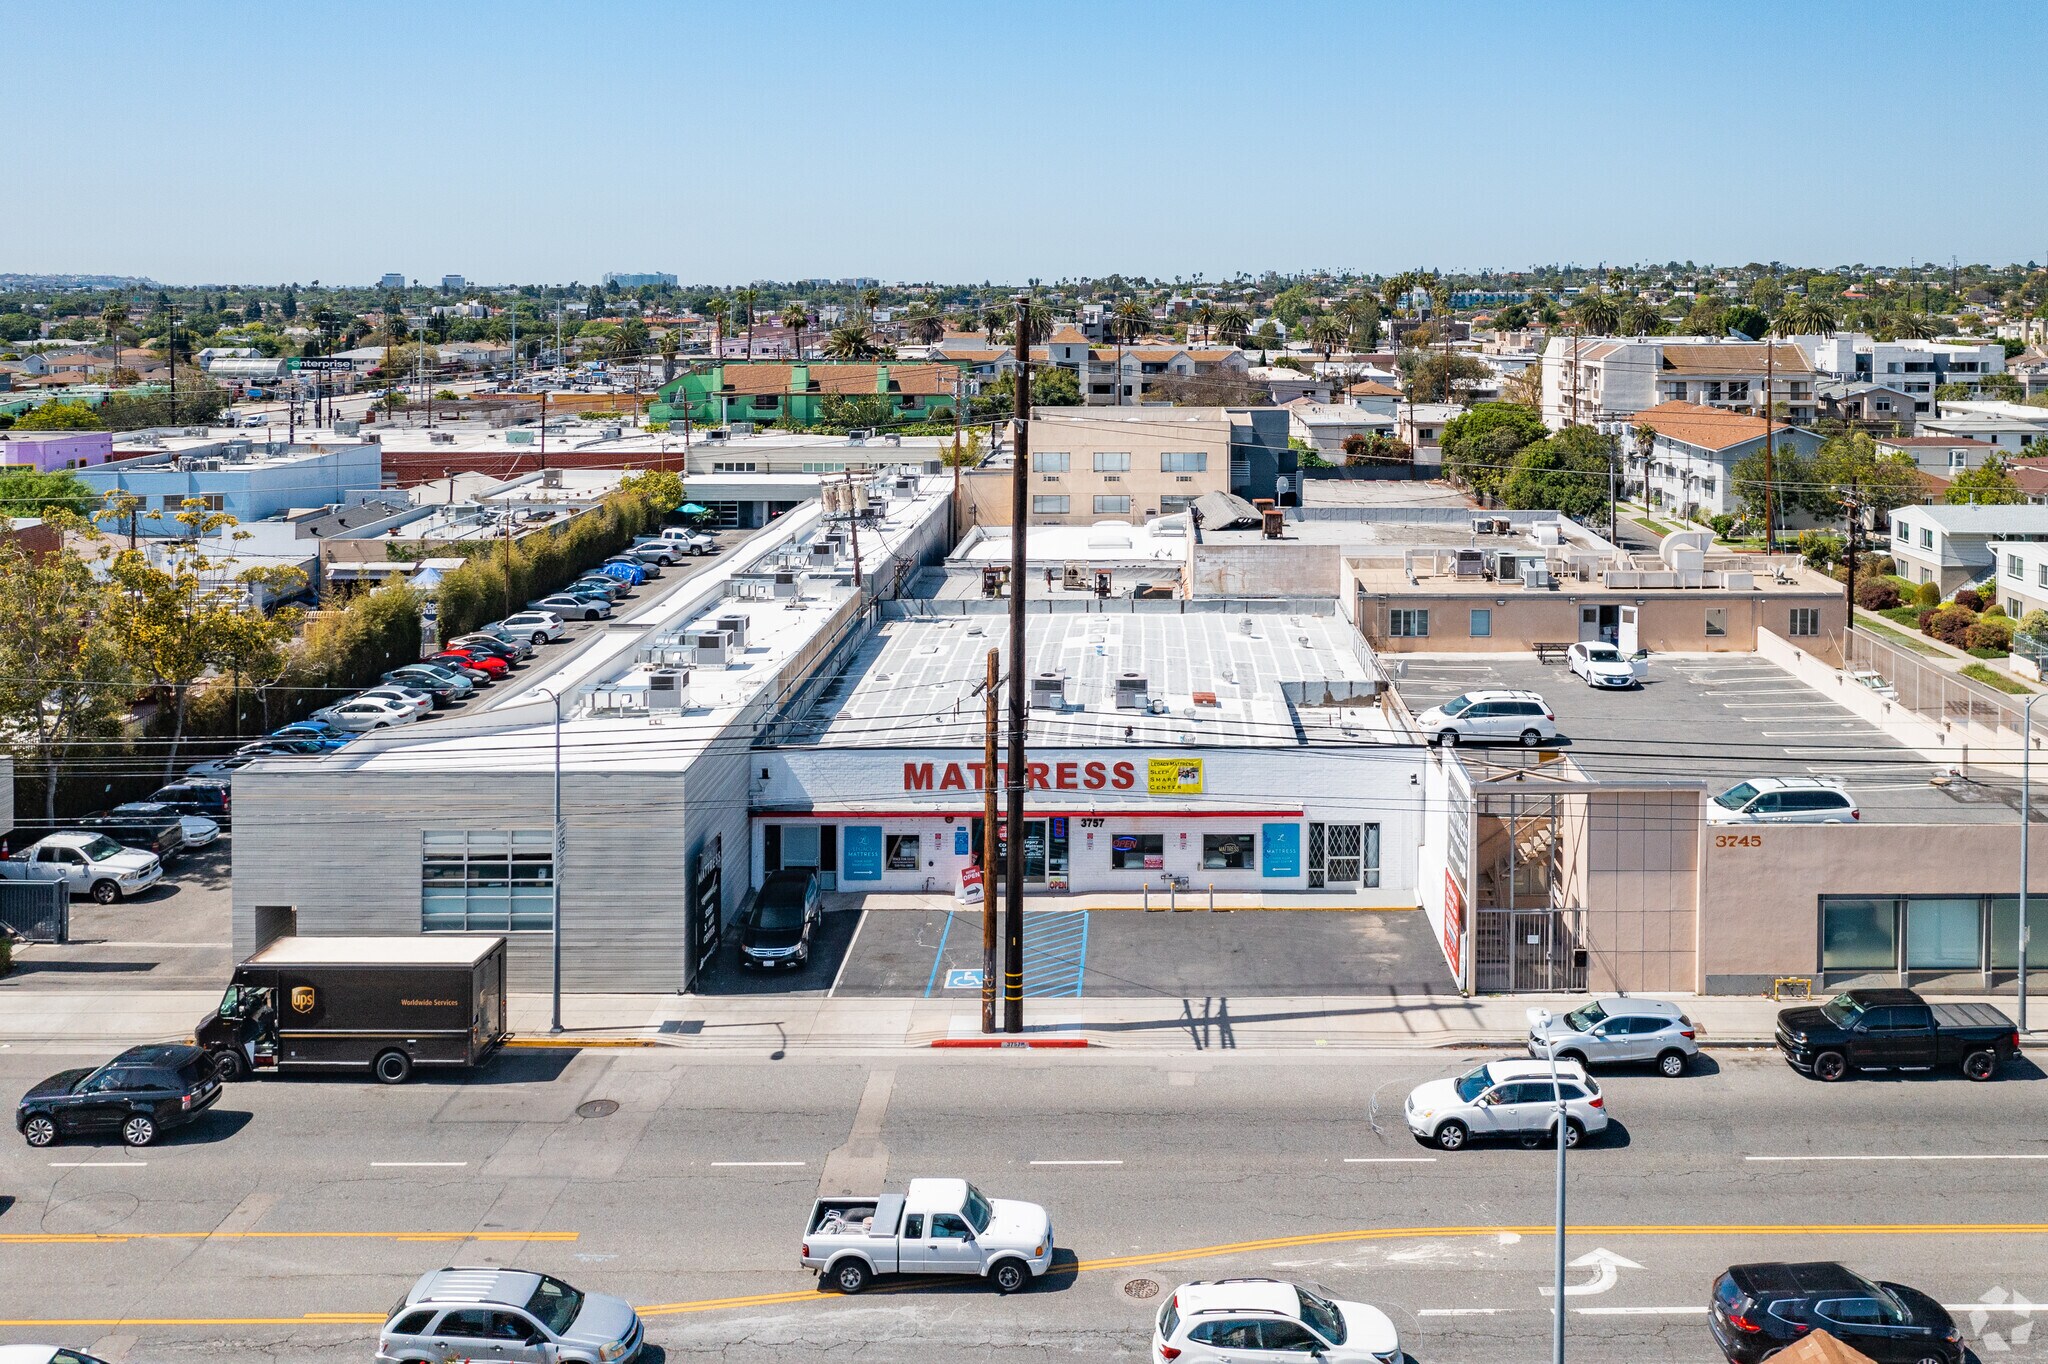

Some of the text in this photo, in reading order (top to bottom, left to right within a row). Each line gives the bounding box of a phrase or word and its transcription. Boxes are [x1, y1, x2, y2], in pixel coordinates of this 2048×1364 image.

[291, 360, 350, 369] enterprise
[904, 762, 1135, 790] MATTRESS
[1080, 818, 1105, 828] 3757
[1112, 839, 1137, 849] OPEN
[1715, 835, 1762, 848] 3745
[963, 872, 980, 881] OPEN
[1049, 881, 1067, 890] OPEN
[294, 994, 313, 1009] ups
